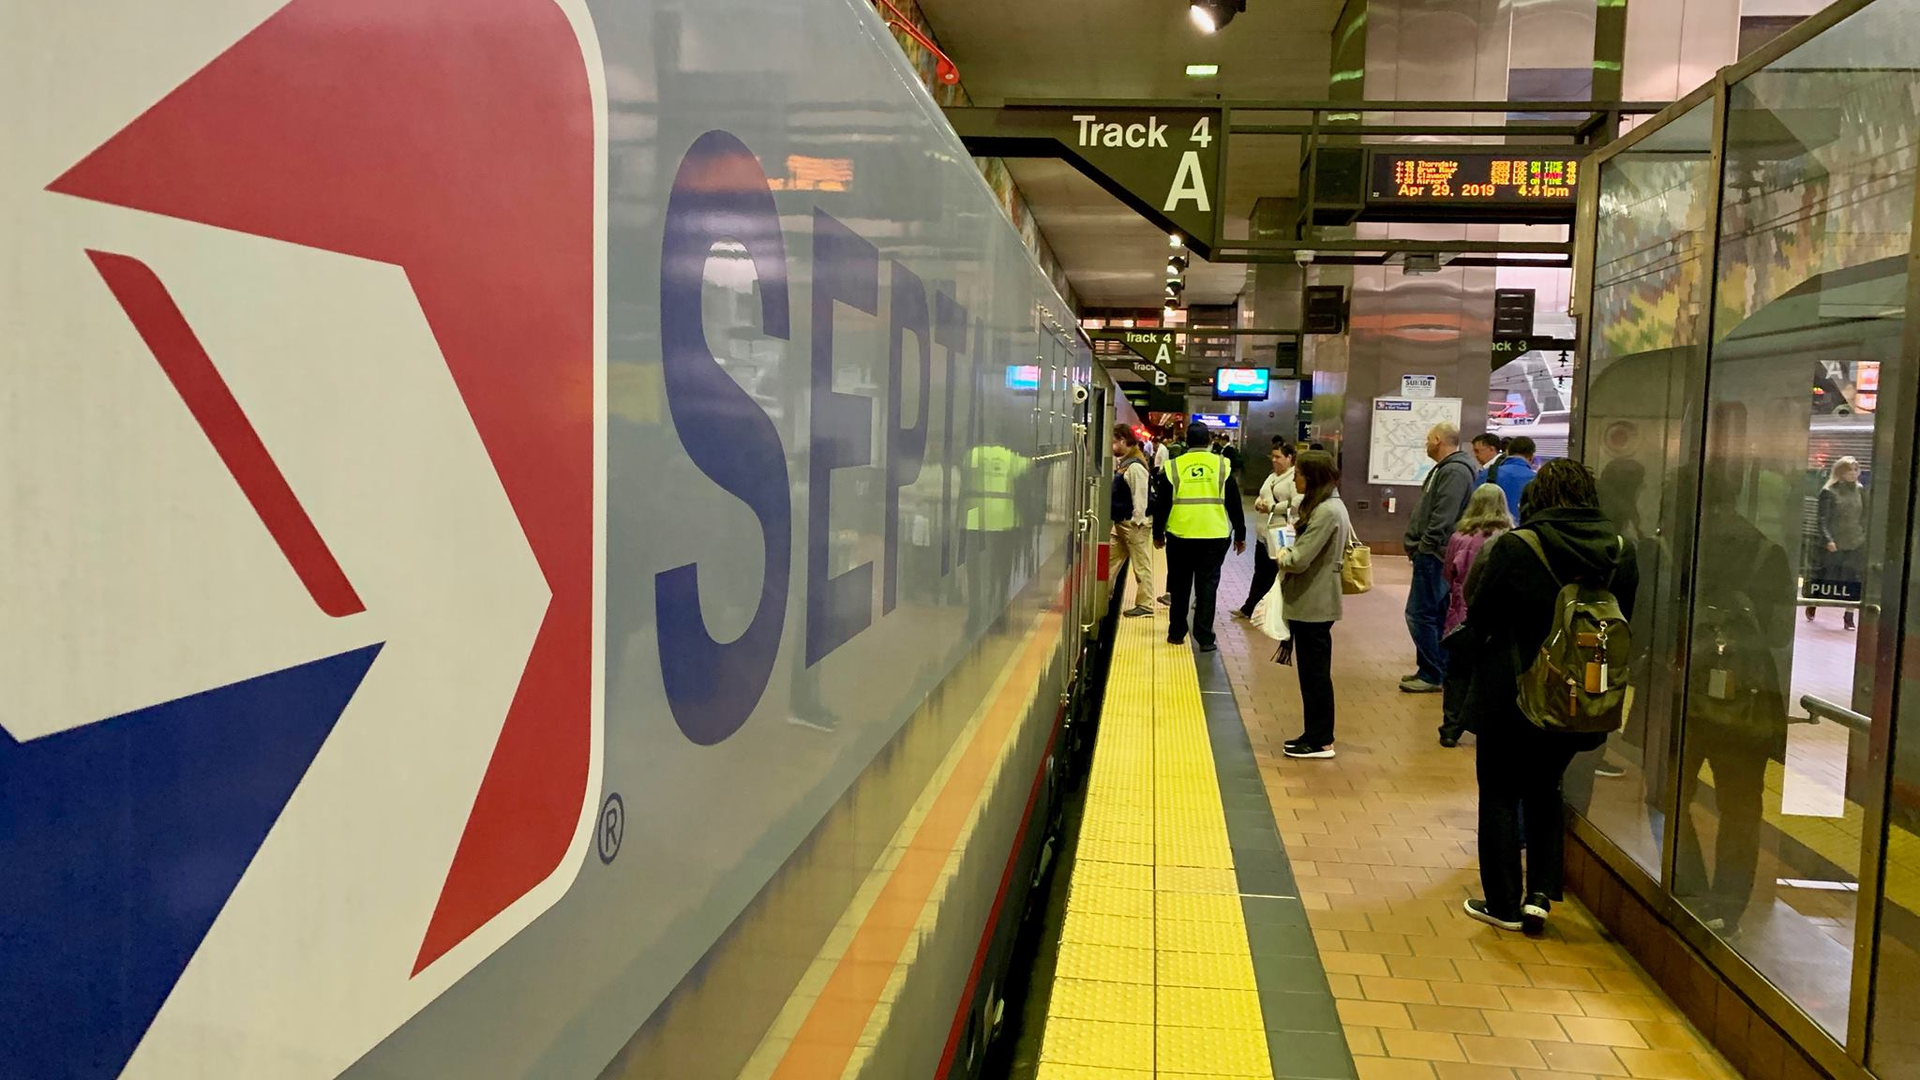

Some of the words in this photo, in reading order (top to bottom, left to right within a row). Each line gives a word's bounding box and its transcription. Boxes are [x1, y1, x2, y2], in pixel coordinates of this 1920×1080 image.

[1072, 114, 1169, 148] Track
[1189, 116, 1212, 148] 4
[1163, 150, 1211, 212] A
[1397, 184, 1425, 197] Apr
[1461, 184, 1495, 196] 2019
[1518, 184, 1570, 197] 4:41pm
[1126, 332, 1157, 343] Track
[1162, 333, 1172, 343] 4
[1492, 341, 1512, 351] ack
[1517, 340, 1527, 351] 3
[1154, 344, 1171, 364] A
[1133, 362, 1156, 371] Track
[1155, 372, 1168, 386] B
[655, 130, 986, 745] SEPTA
[1810, 583, 1851, 597] PULL
